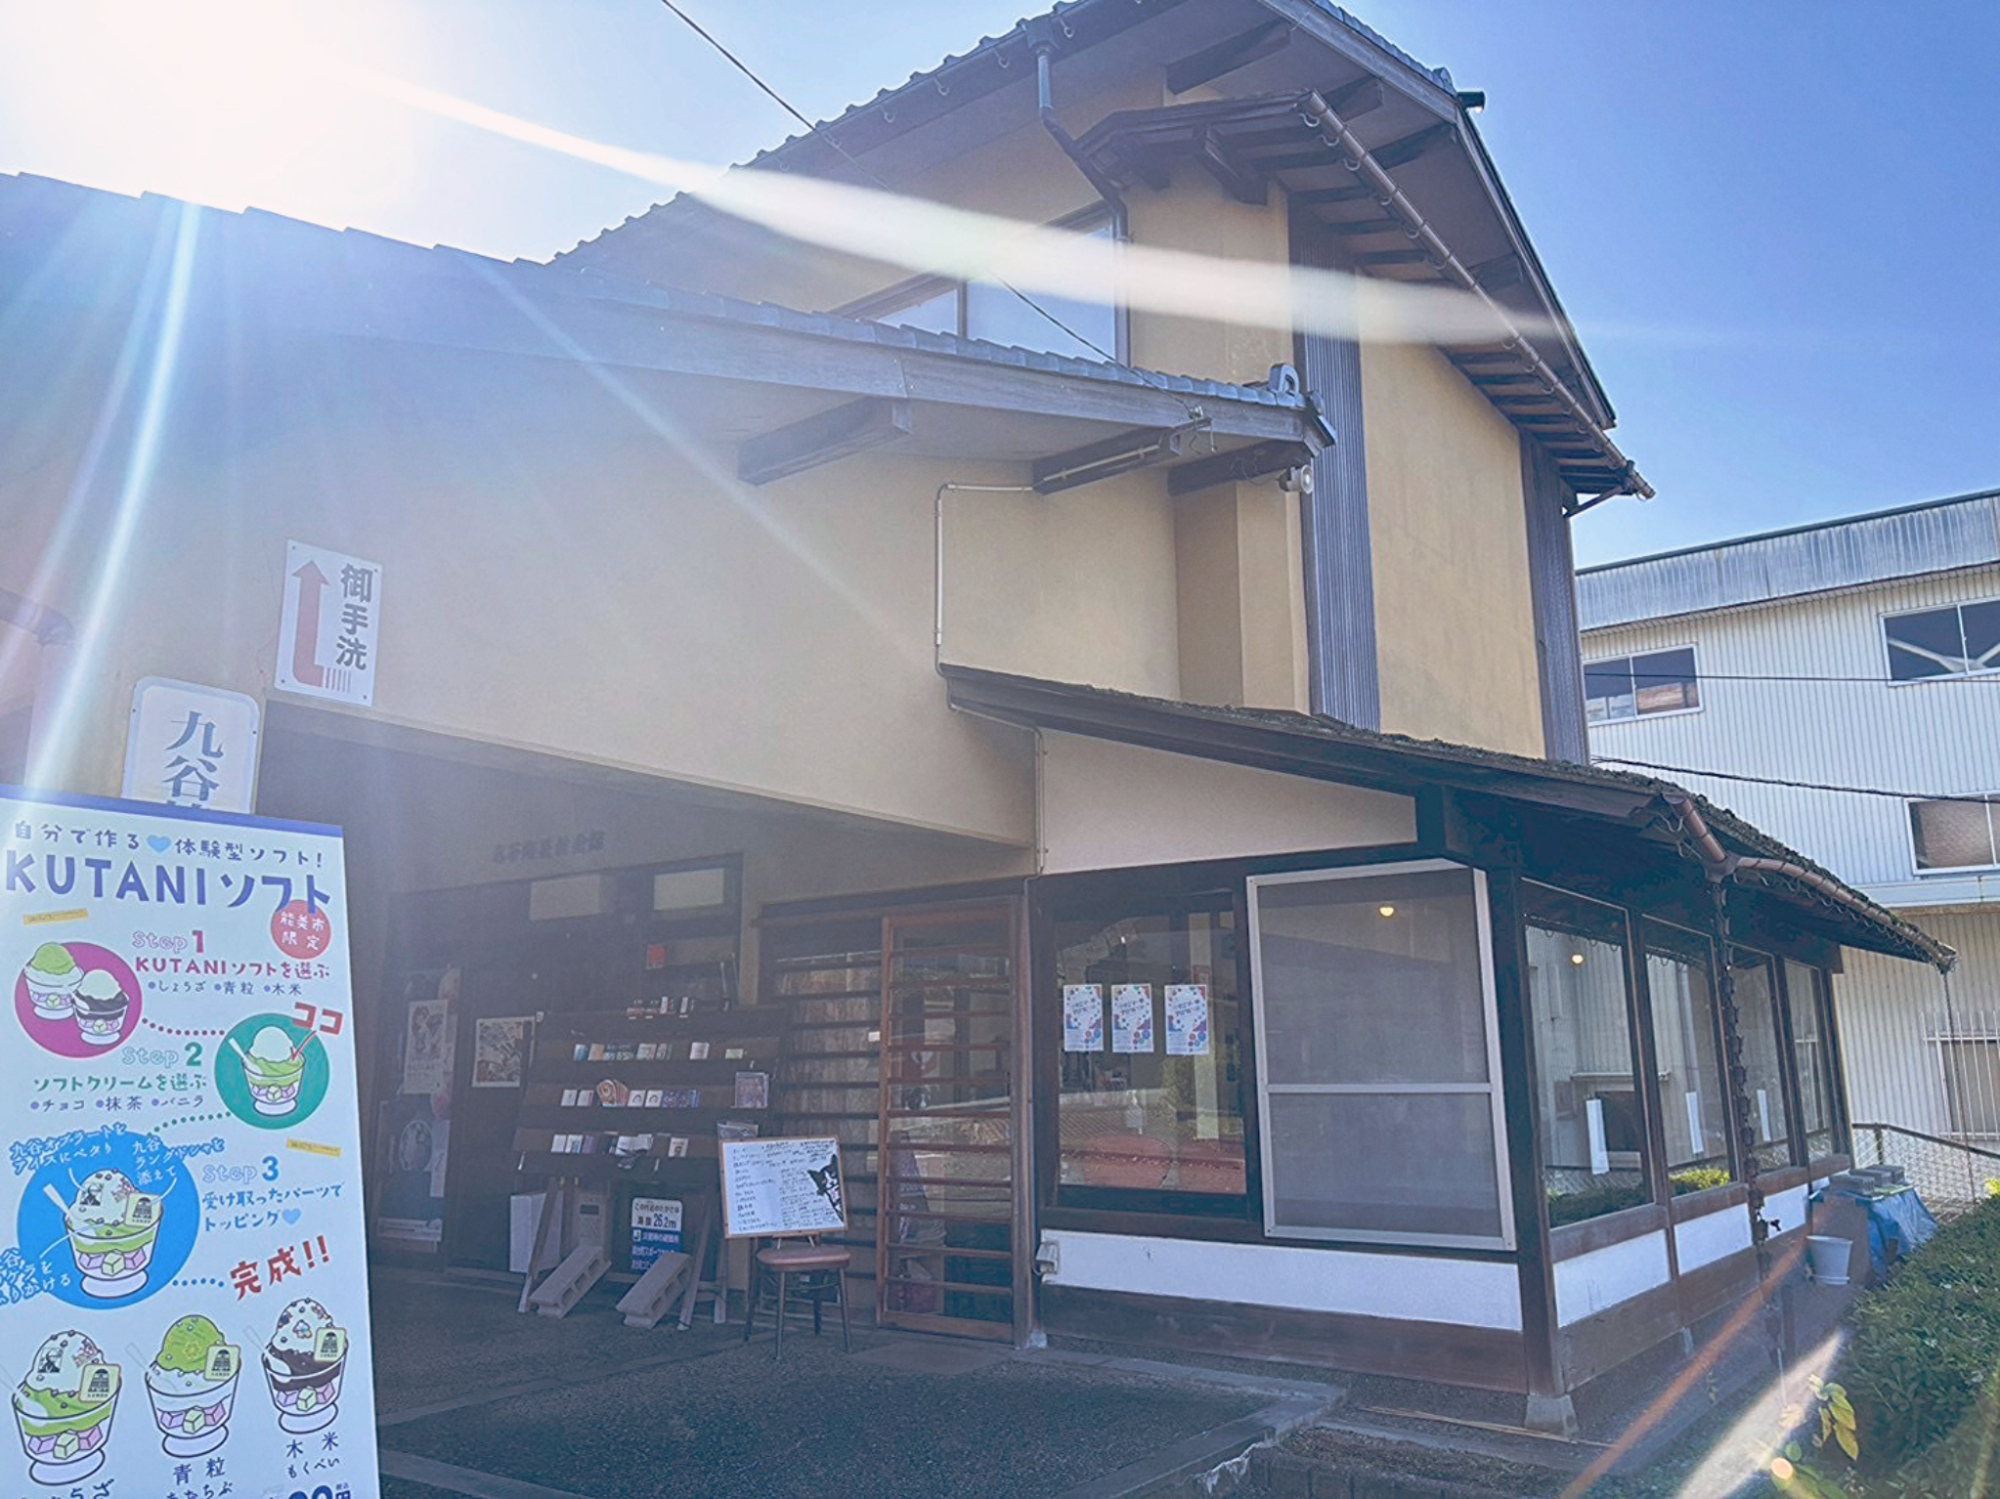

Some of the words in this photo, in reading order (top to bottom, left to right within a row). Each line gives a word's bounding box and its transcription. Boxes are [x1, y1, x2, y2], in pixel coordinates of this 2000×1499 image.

[336, 563, 373, 671] 御手洗
[162, 711, 224, 809] 九谷
[15, 819, 140, 850] 自分で作る
[175, 838, 323, 868] 体験型ソフト!
[5, 850, 331, 914] KUTANIソフト
[132, 930, 188, 954] Step
[192, 930, 204, 953] 1
[281, 930, 320, 951] 限定
[136, 956, 330, 979] KUTANIソフトを選ぶ
[292, 1001, 344, 1036] ココ
[122, 1046, 179, 1069] Step
[185, 1042, 203, 1067] 2
[34, 1073, 207, 1092] ソフトクリームを選ぶ
[42, 1099, 85, 1112] チョコ
[105, 1095, 142, 1111] 抹茶
[161, 1094, 204, 1108] バニラ
[202, 1164, 258, 1185] Step
[262, 1155, 279, 1181] 3
[229, 1235, 332, 1301] 完成!!
[285, 1431, 340, 1459] 木米
[172, 1457, 226, 1486] 青粒
[287, 1456, 341, 1478] もくべい
